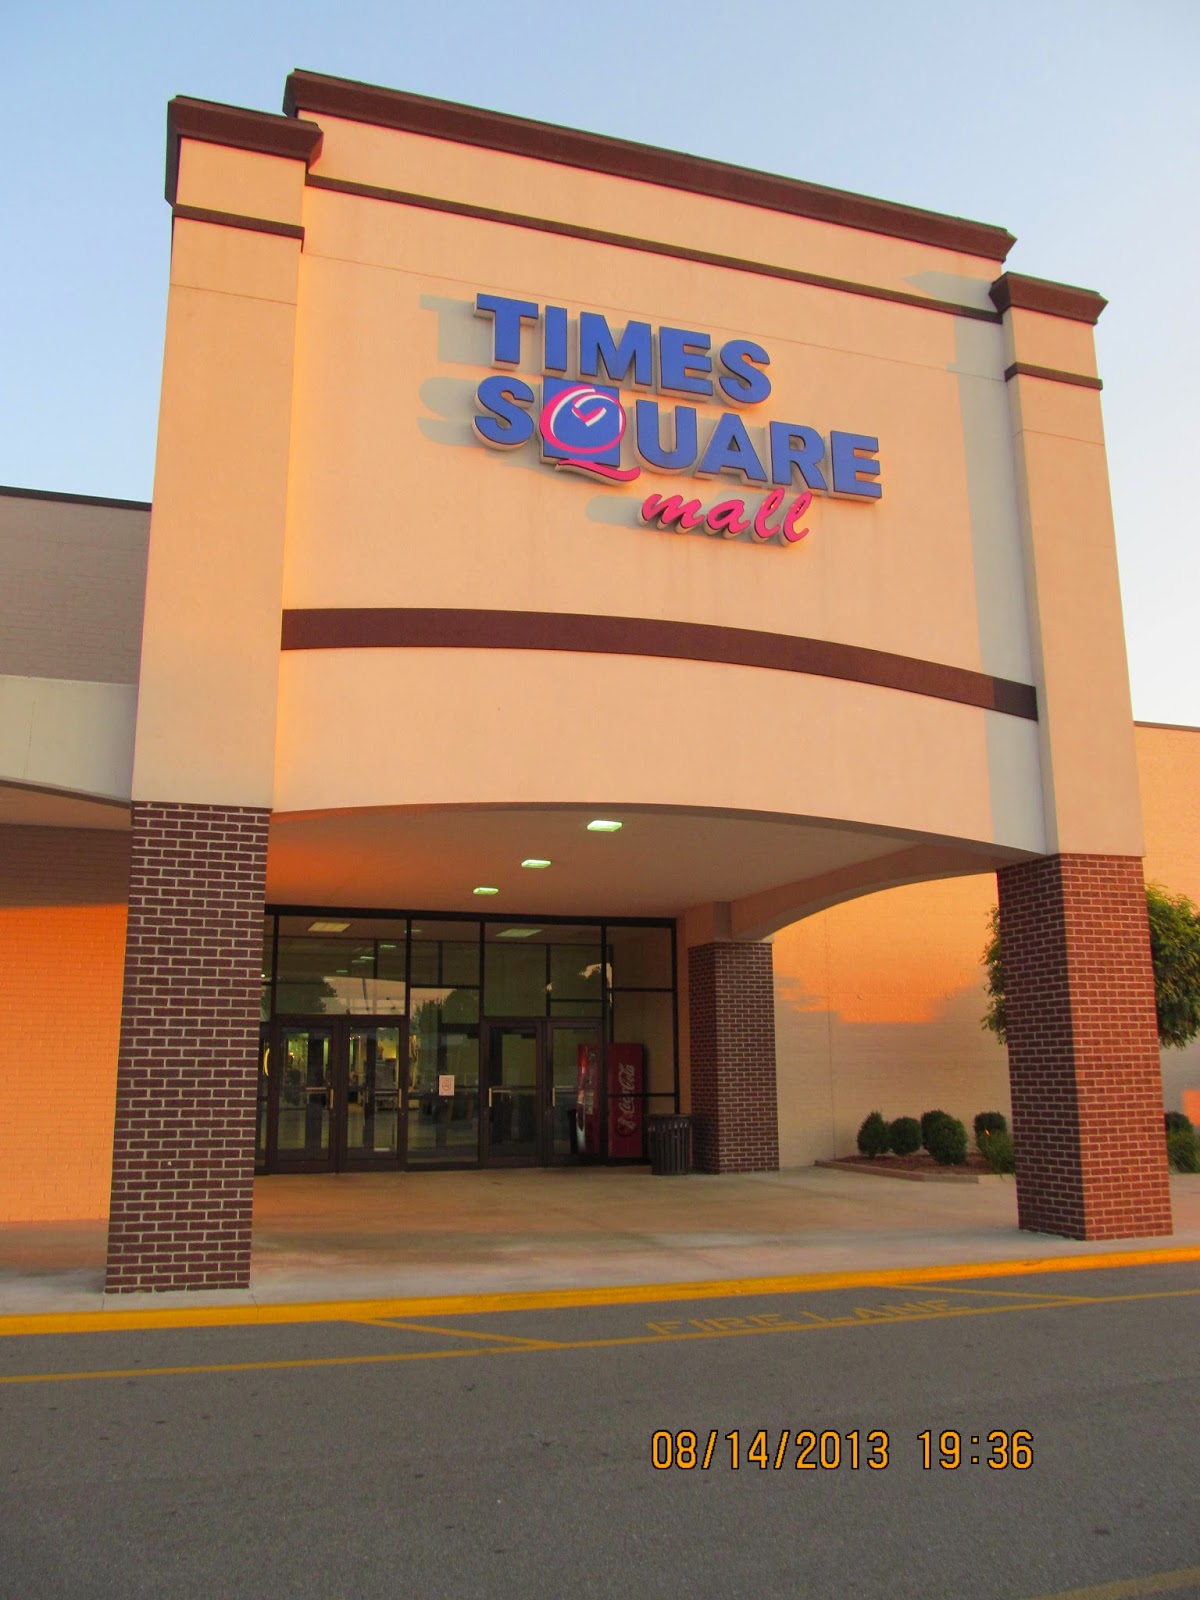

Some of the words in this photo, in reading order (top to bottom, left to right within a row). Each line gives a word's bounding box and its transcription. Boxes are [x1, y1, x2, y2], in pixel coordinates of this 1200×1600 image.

[475, 293, 773, 406] TIMES
[472, 374, 883, 499] SQUARE
[640, 487, 813, 545] mall
[646, 1313, 799, 1335] FIRE
[800, 1299, 970, 1323] LANE
